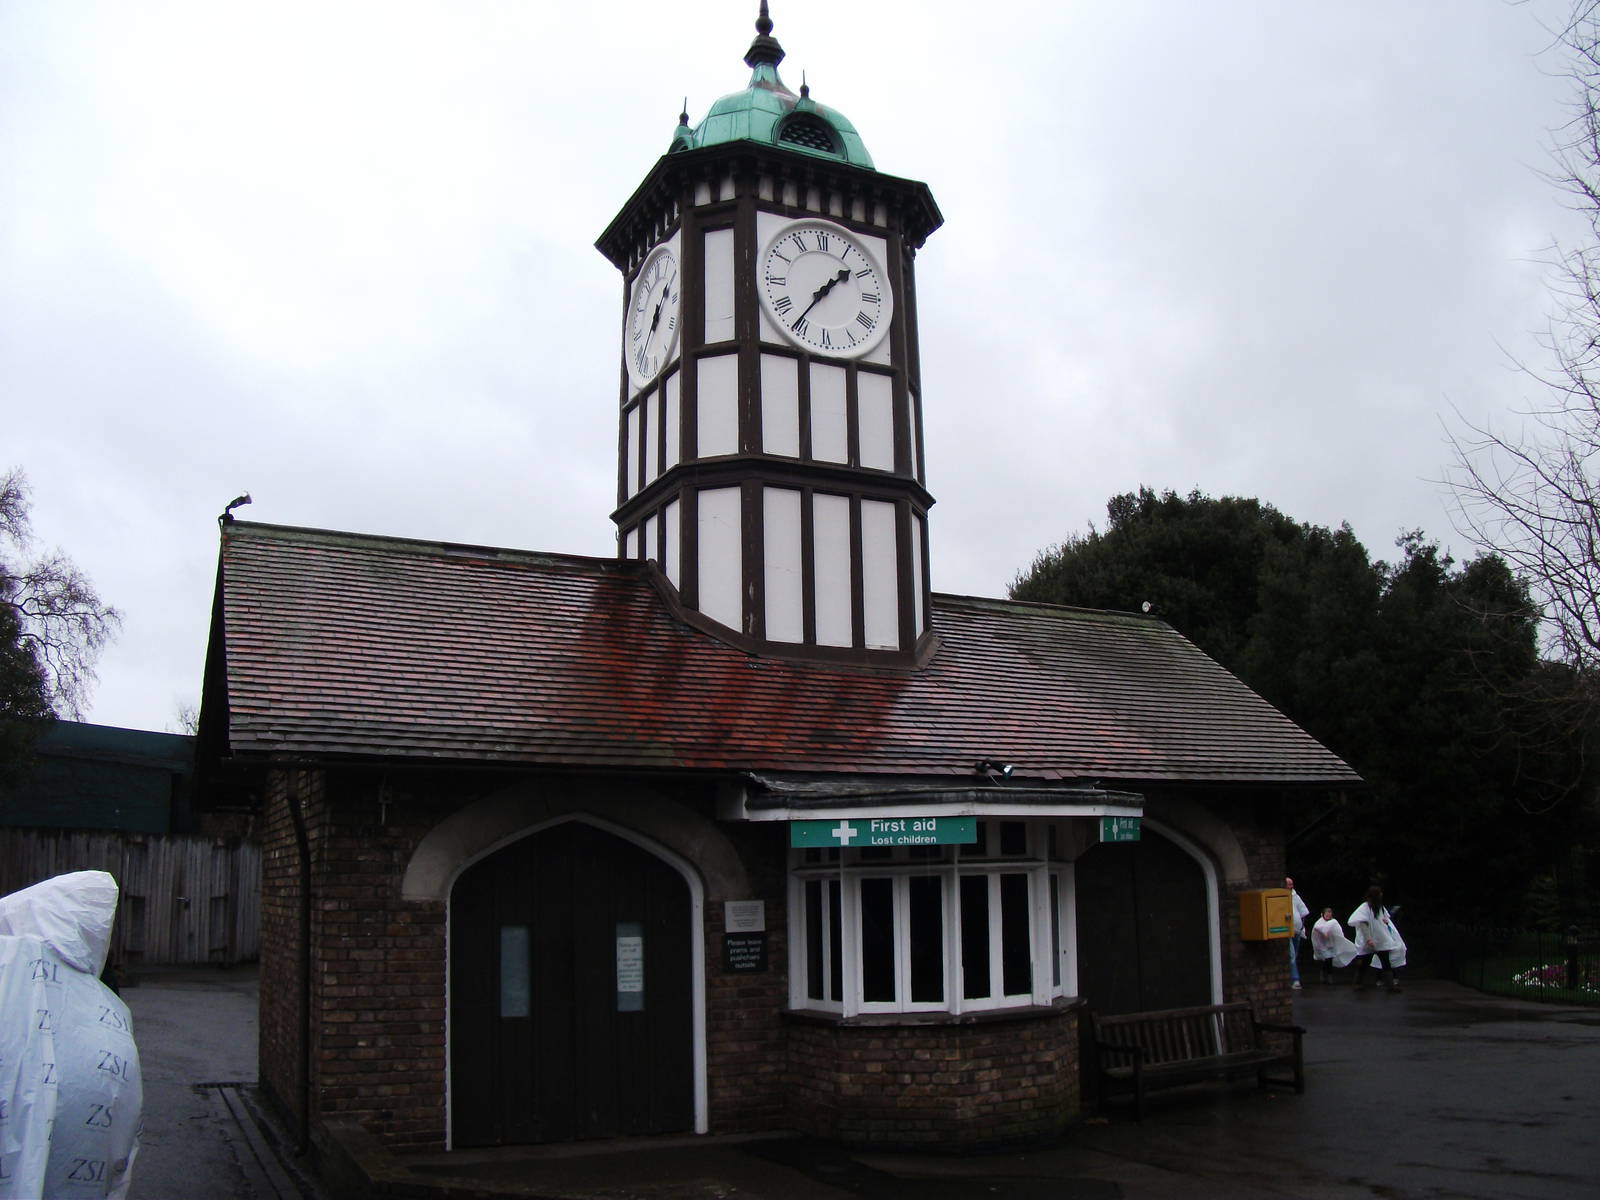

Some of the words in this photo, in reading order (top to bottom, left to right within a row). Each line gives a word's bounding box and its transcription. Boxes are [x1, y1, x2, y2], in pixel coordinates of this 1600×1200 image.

[817, 235, 829, 252] XII
[855, 269, 870, 279] II
[776, 296, 792, 315] VIII
[862, 292, 878, 304] III
[871, 819, 906, 832] First
[913, 818, 936, 831] aid
[871, 836, 893, 845] Lost
[897, 835, 936, 844] children
[97, 1049, 129, 1082] ZSL
[68, 1158, 106, 1182] ZSL
